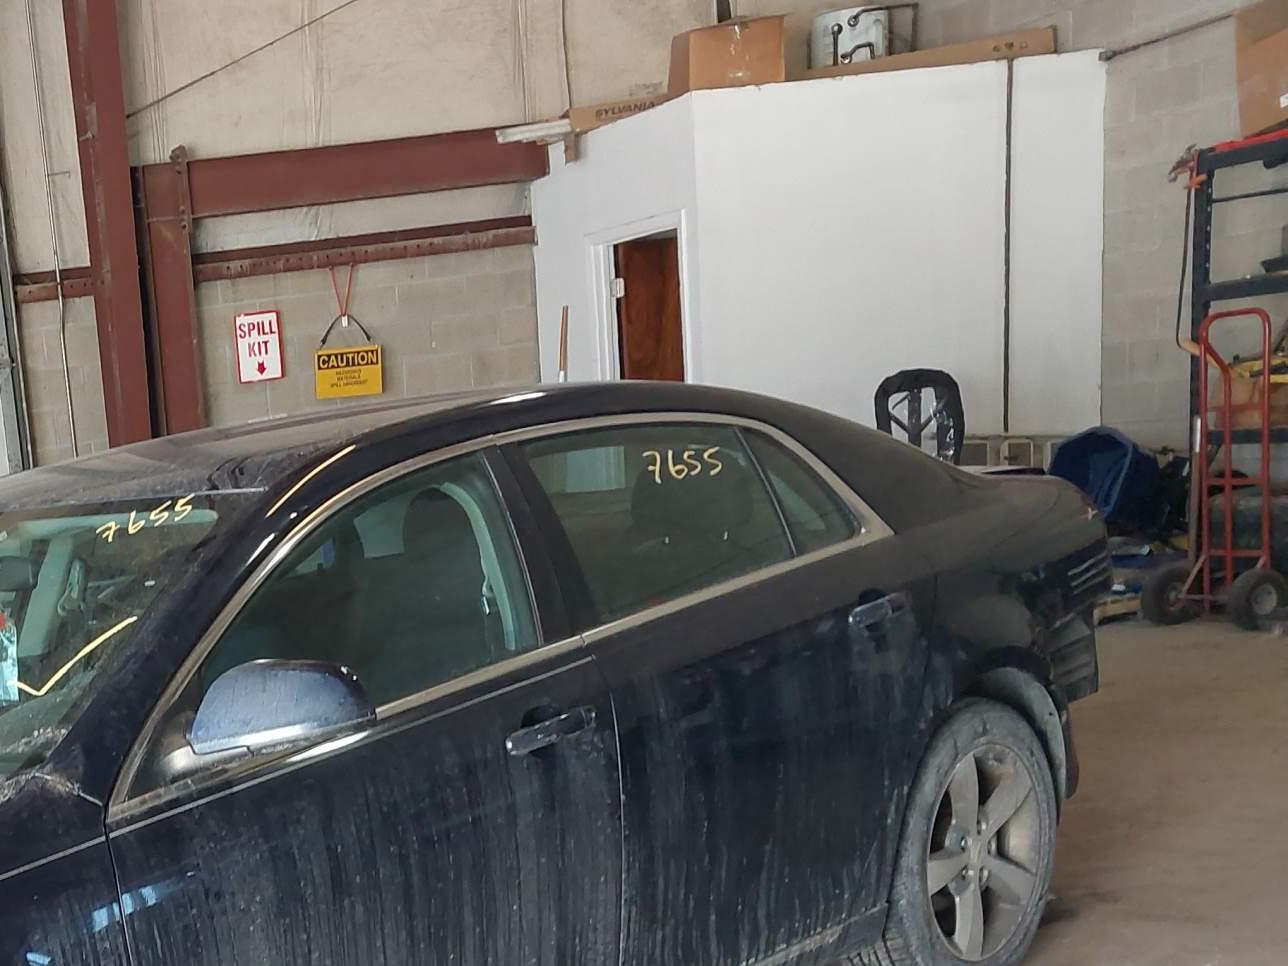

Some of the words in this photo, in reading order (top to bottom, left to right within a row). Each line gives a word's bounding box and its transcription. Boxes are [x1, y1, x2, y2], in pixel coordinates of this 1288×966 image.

[238, 319, 277, 340] SPILL
[248, 340, 270, 358] KIT
[319, 350, 377, 369] CAUTION
[642, 446, 723, 485] 7655
[95, 492, 196, 543] 7655
